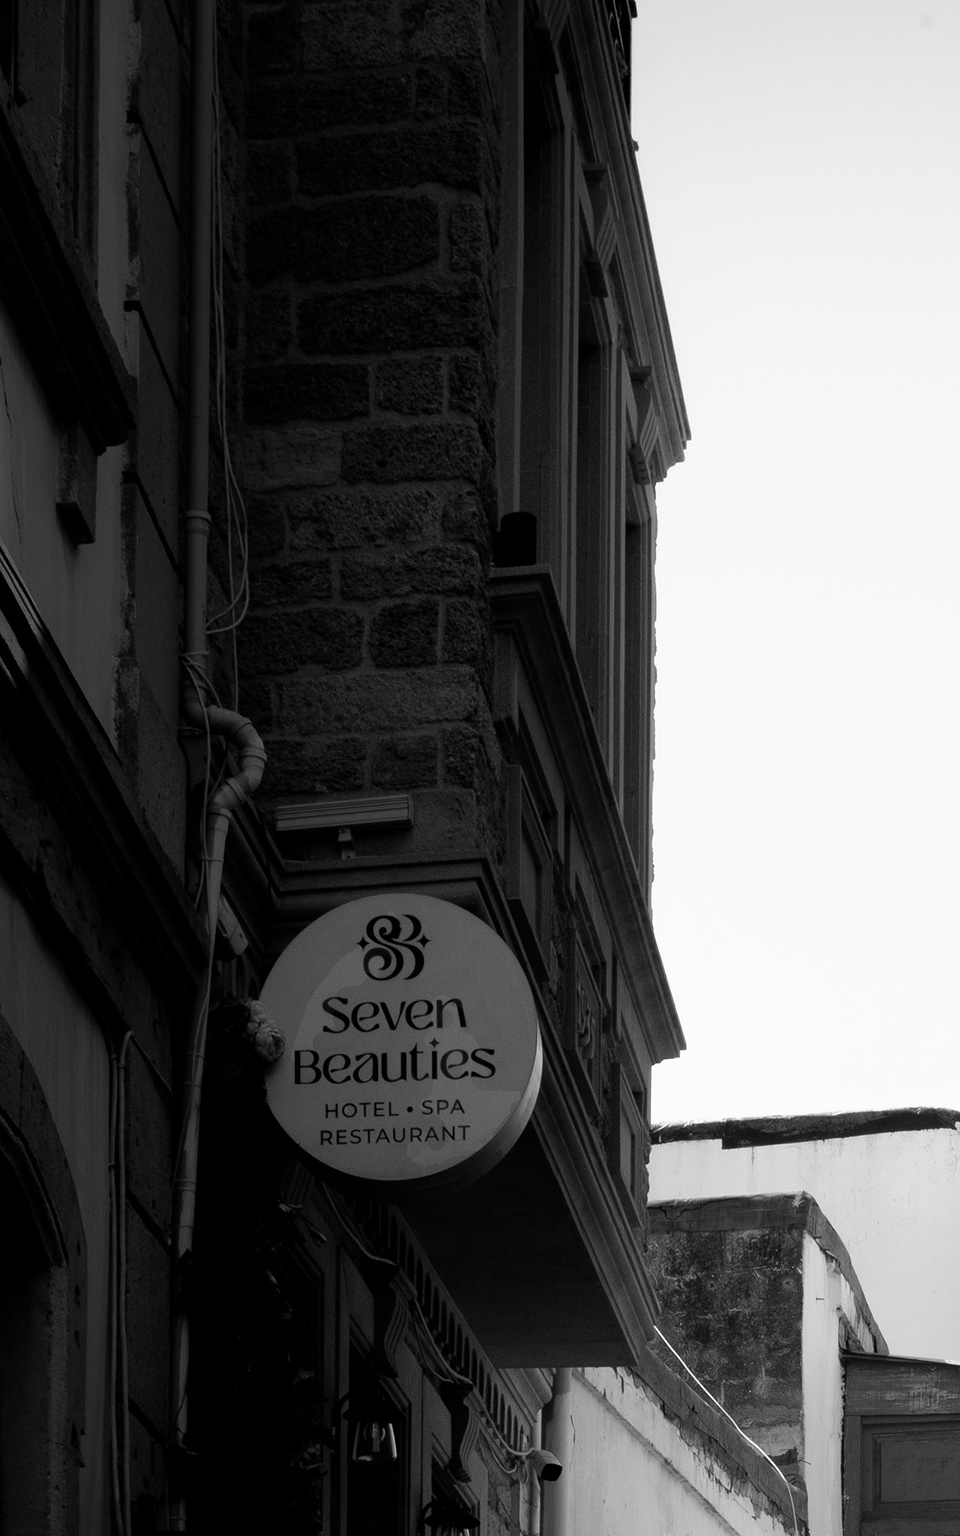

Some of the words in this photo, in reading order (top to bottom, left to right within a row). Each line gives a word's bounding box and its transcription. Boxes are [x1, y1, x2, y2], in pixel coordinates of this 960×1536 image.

[321, 996, 468, 1034] Seven
[293, 1037, 497, 1085] Beauties
[324, 1101, 400, 1119] HOTEL
[420, 1098, 466, 1116] SPA
[319, 1124, 472, 1146] RESTAURANT
